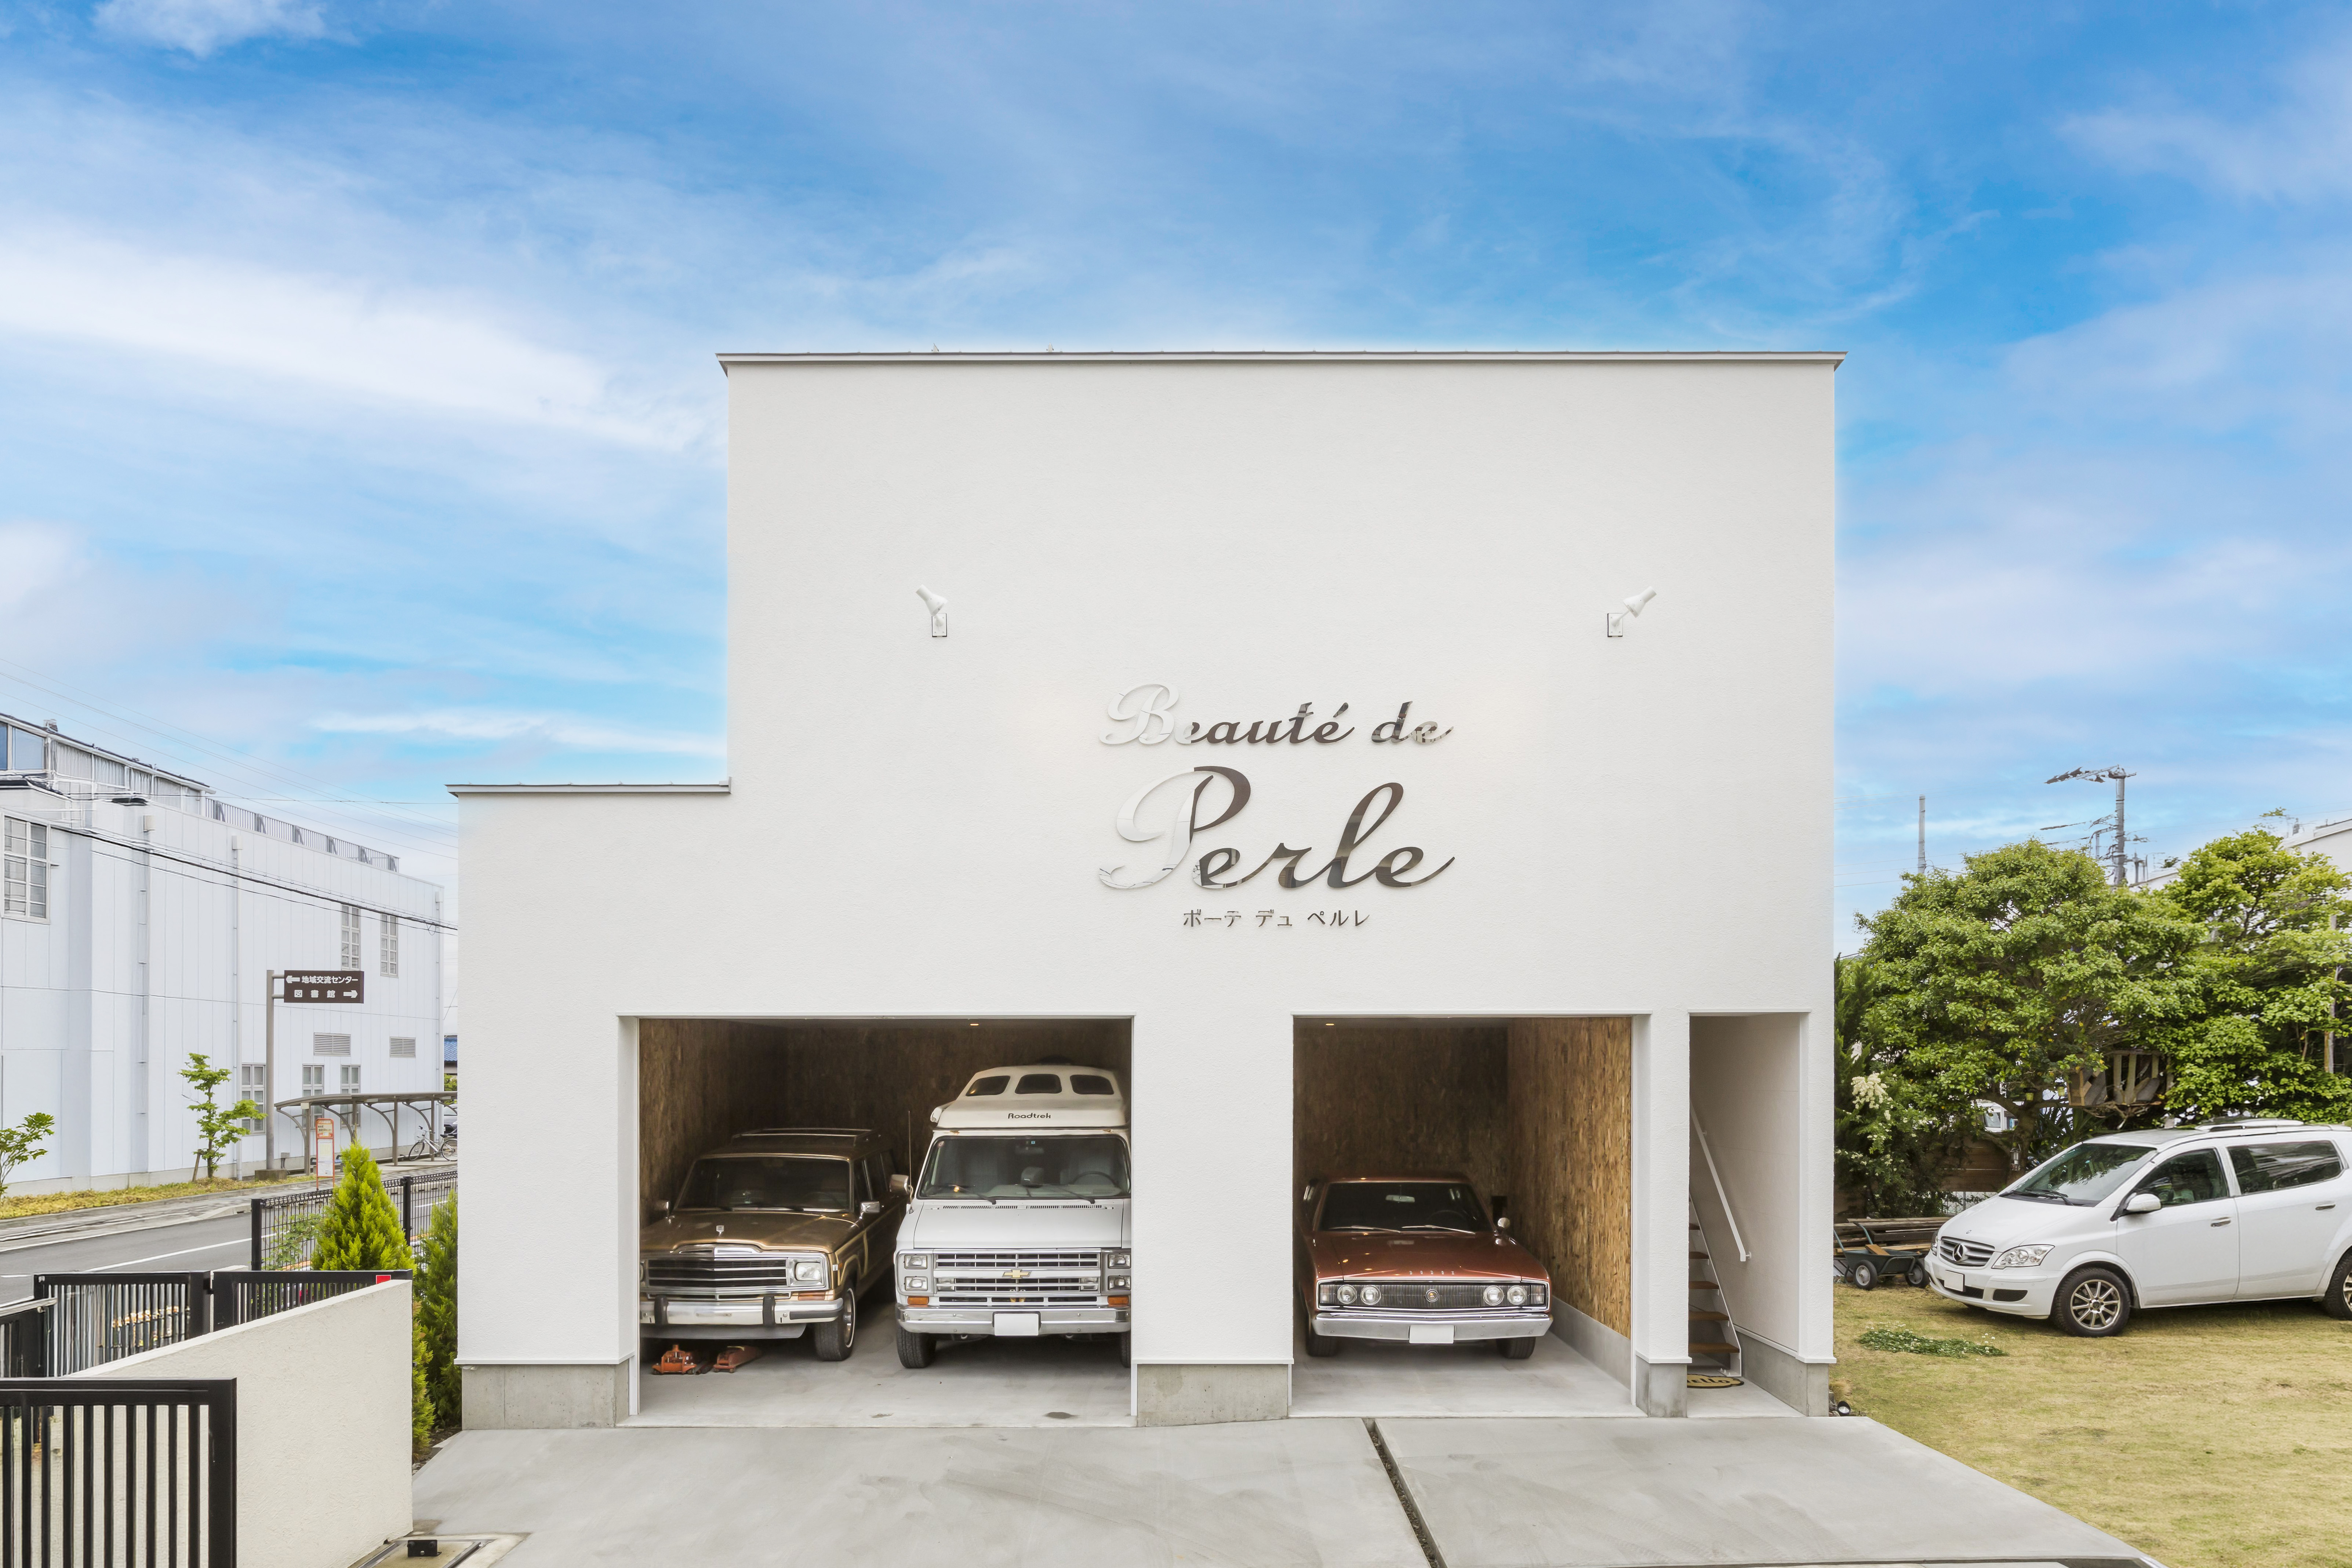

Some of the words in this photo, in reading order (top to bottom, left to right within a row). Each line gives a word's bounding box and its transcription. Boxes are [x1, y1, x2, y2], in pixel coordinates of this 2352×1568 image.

[1099, 684, 1355, 744] Beauté
[1371, 701, 1454, 744] de
[1099, 765, 1455, 889] Perle
[1183, 909, 1242, 927] ボーテ
[1255, 909, 1293, 927] デュ
[1307, 910, 1370, 927] ペルレ
[301, 975, 358, 984] 地域交流センター
[294, 990, 335, 998] 図書館
